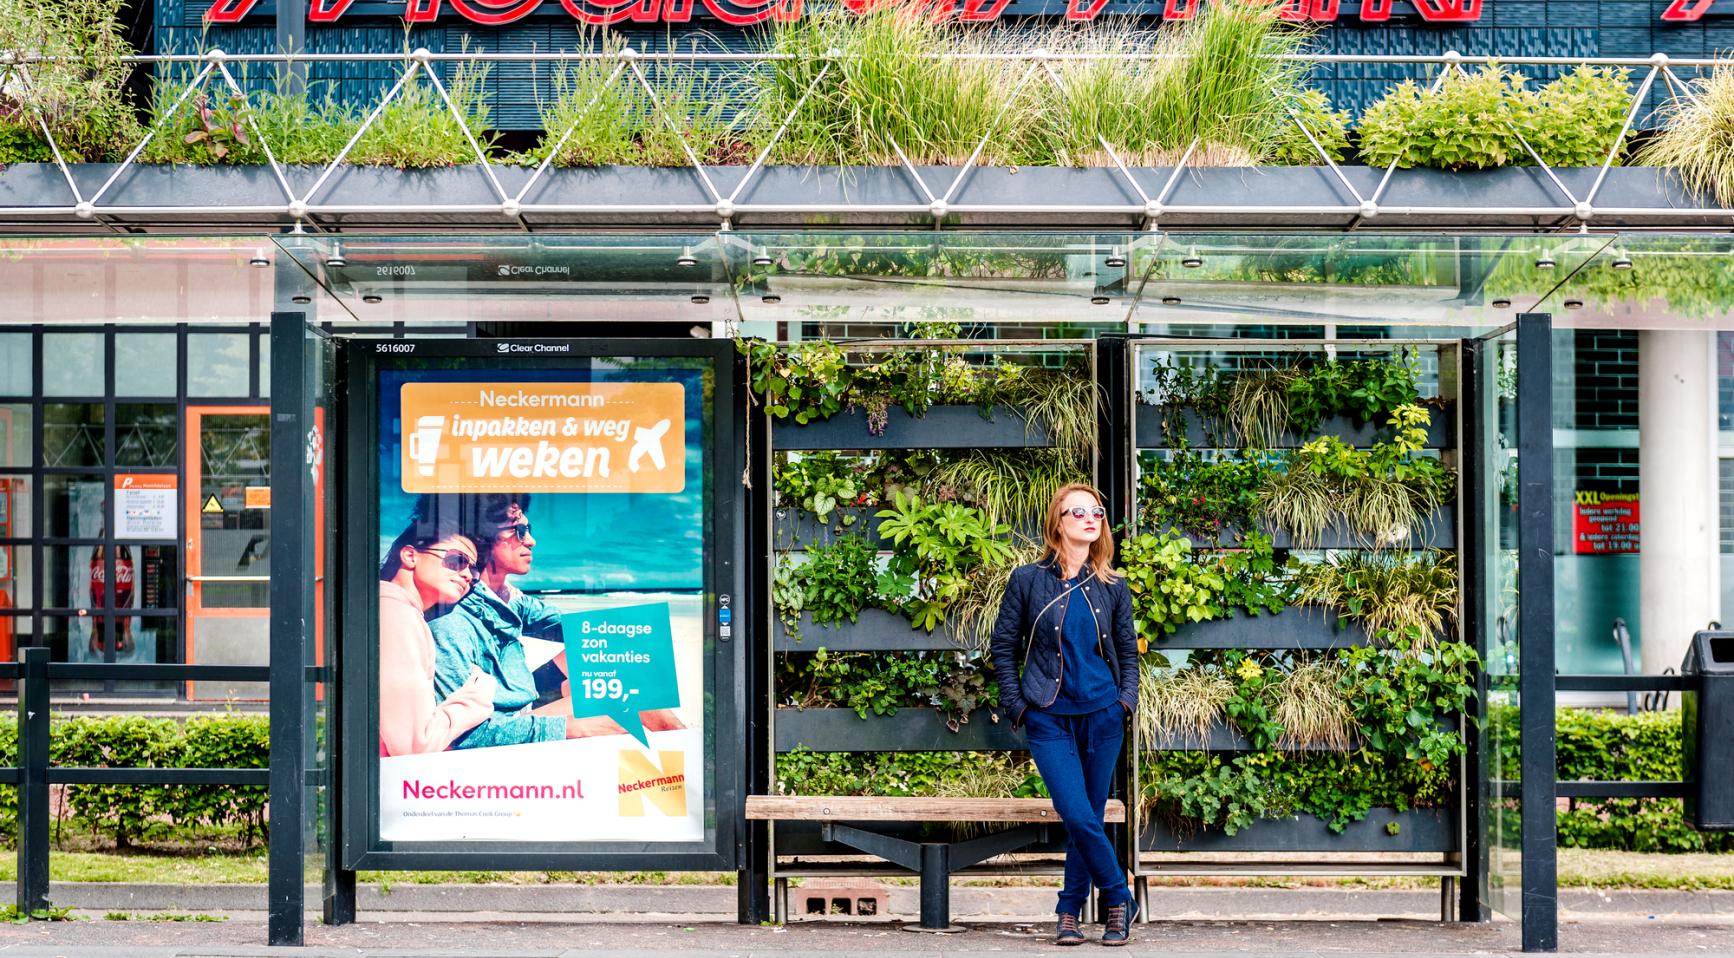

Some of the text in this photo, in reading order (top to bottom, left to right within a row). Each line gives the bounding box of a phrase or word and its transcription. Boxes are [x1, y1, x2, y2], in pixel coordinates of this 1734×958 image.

[376, 344, 416, 353] 5616007
[510, 343, 570, 353] Clear Channel
[479, 390, 604, 408] Neckermann
[452, 414, 631, 441] inpakken & weg
[472, 440, 610, 478] weken
[1576, 491, 1601, 504] XXL
[581, 620, 652, 638] 8-daagse
[581, 638, 608, 650] zon
[581, 650, 650, 664] vakanties
[594, 669, 616, 678] vanaf
[581, 678, 639, 703] 199,-
[402, 779, 584, 800] Neckermann.nl
[618, 774, 685, 794] Neckermann
